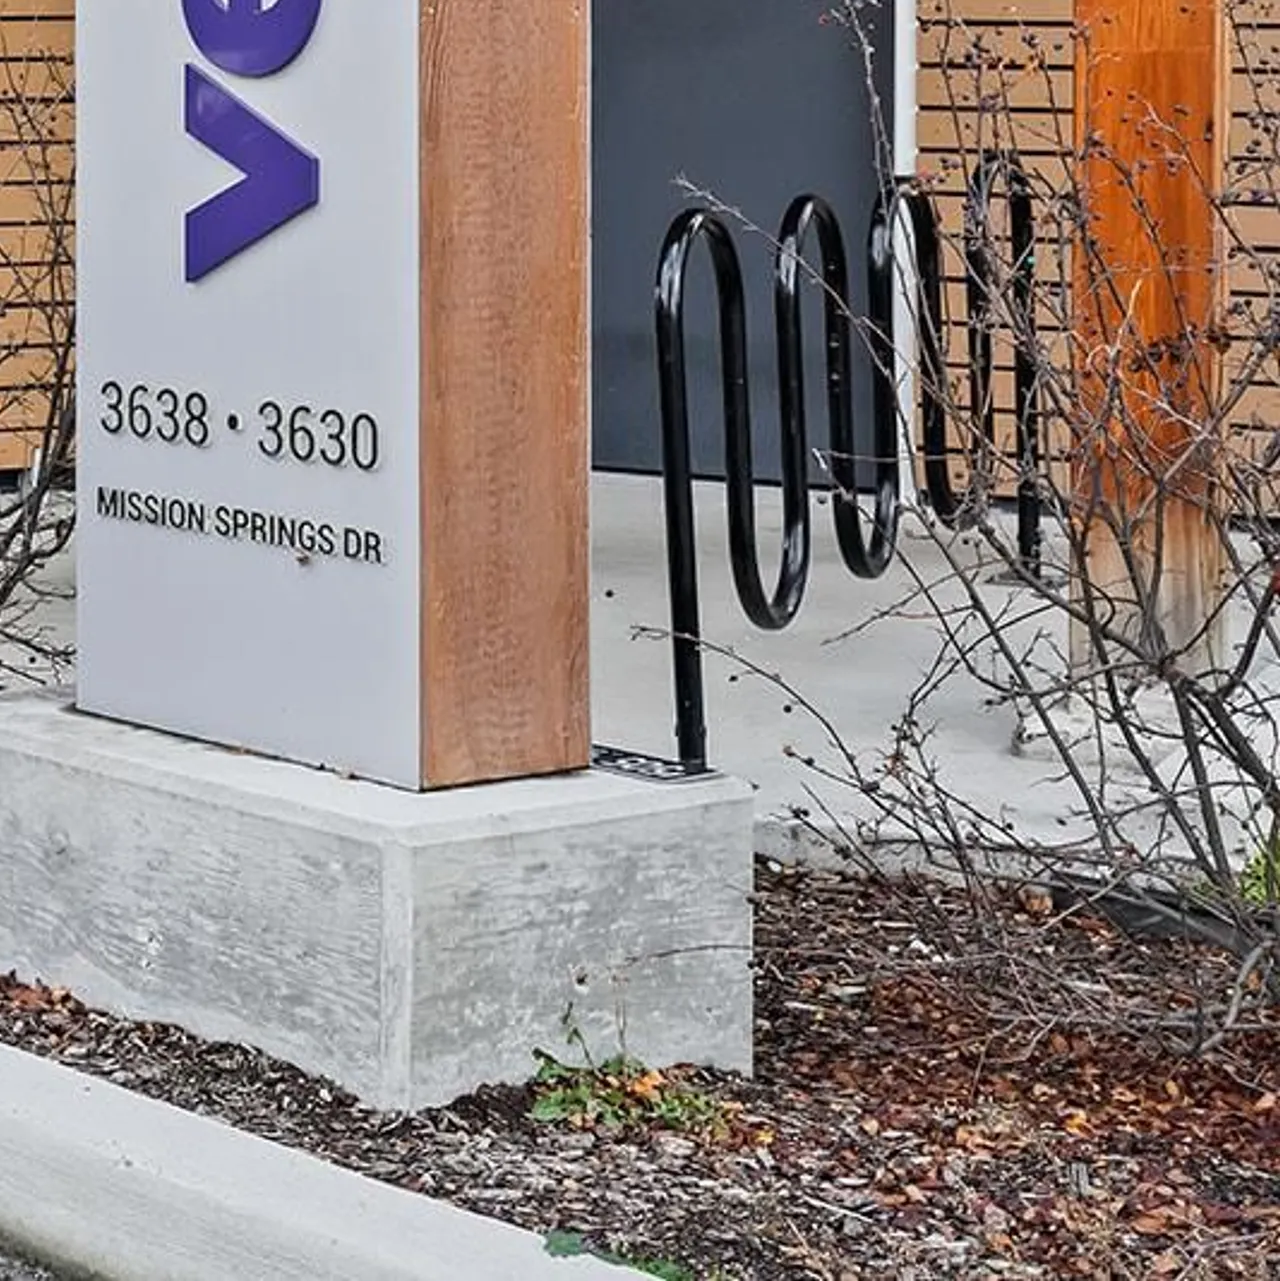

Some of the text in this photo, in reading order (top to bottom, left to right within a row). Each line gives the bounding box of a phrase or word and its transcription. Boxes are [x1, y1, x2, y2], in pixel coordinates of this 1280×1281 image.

[100, 380, 209, 447] 3638
[257, 400, 379, 470] 3630
[97, 486, 382, 563] MISSION SPRINGS DR
